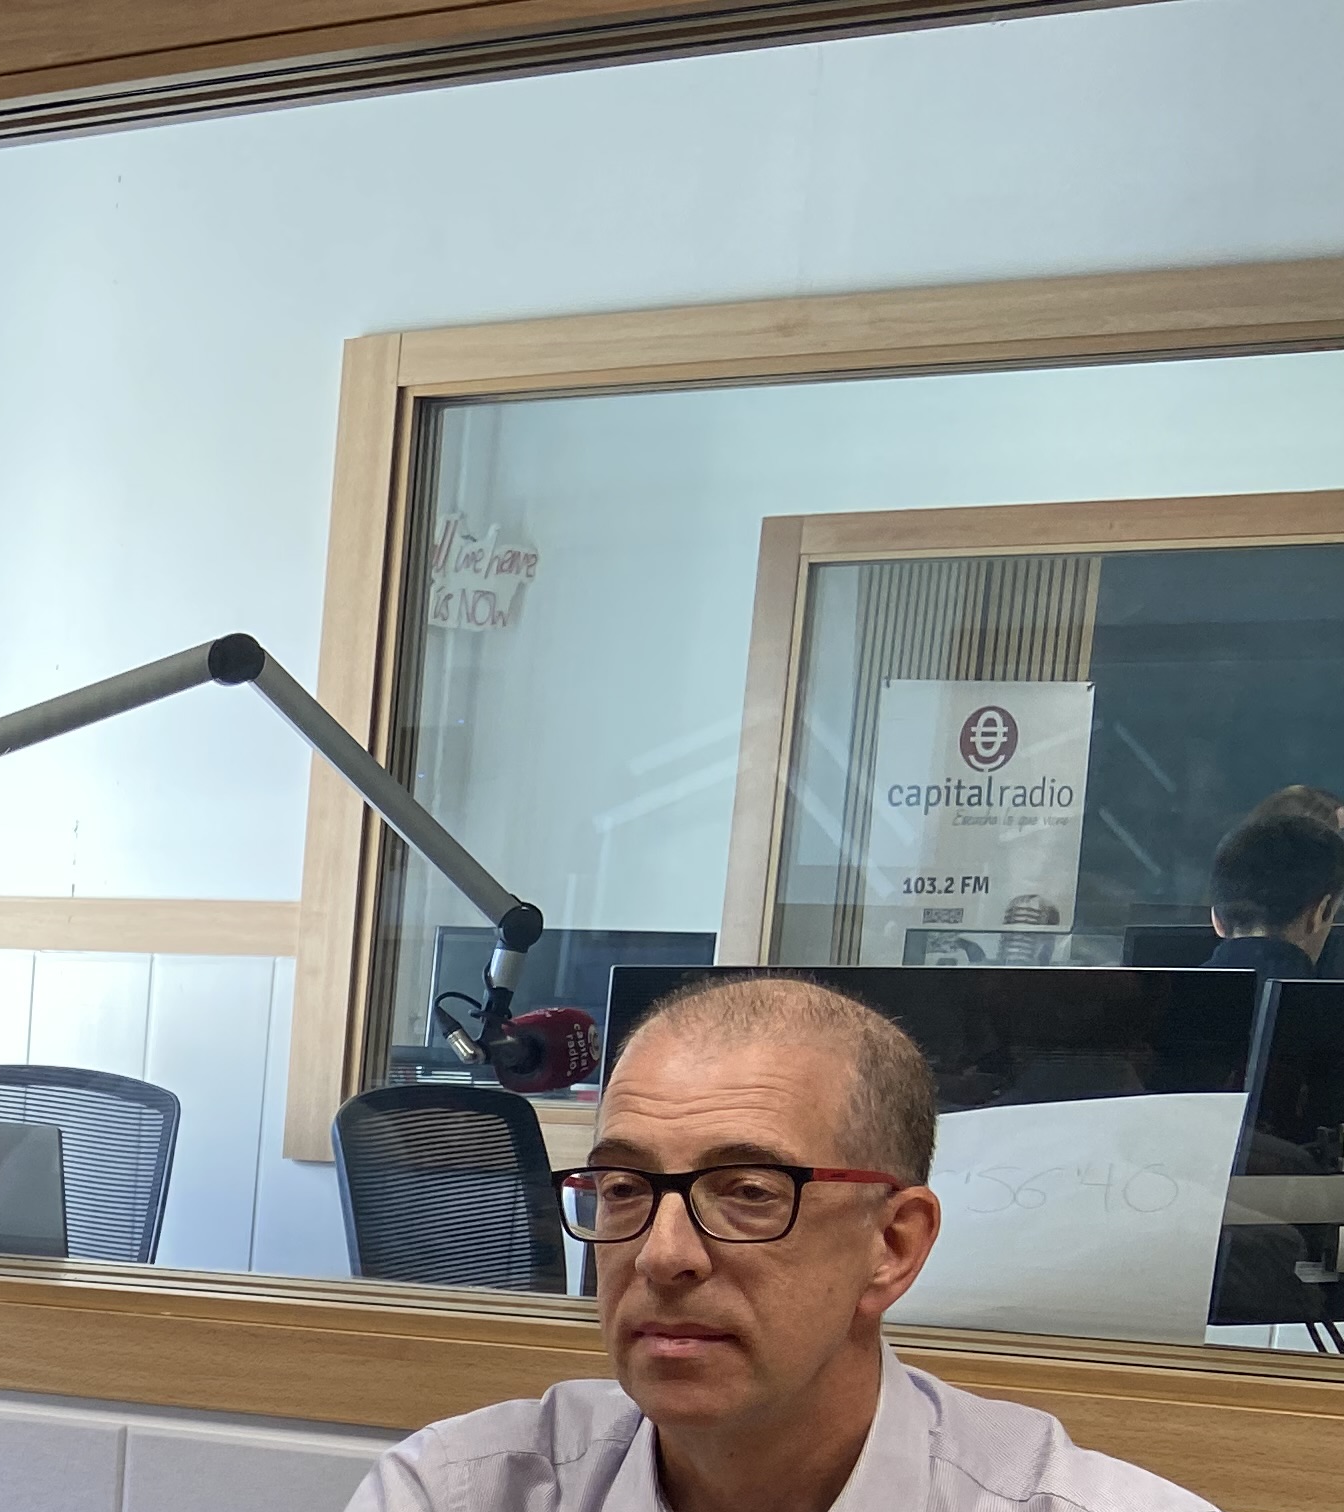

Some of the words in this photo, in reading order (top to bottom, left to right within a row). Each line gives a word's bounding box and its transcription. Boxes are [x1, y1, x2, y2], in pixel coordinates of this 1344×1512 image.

[902, 876, 955, 895] 103.2
[960, 875, 990, 895] FM
[573, 1023, 590, 1073] capital
